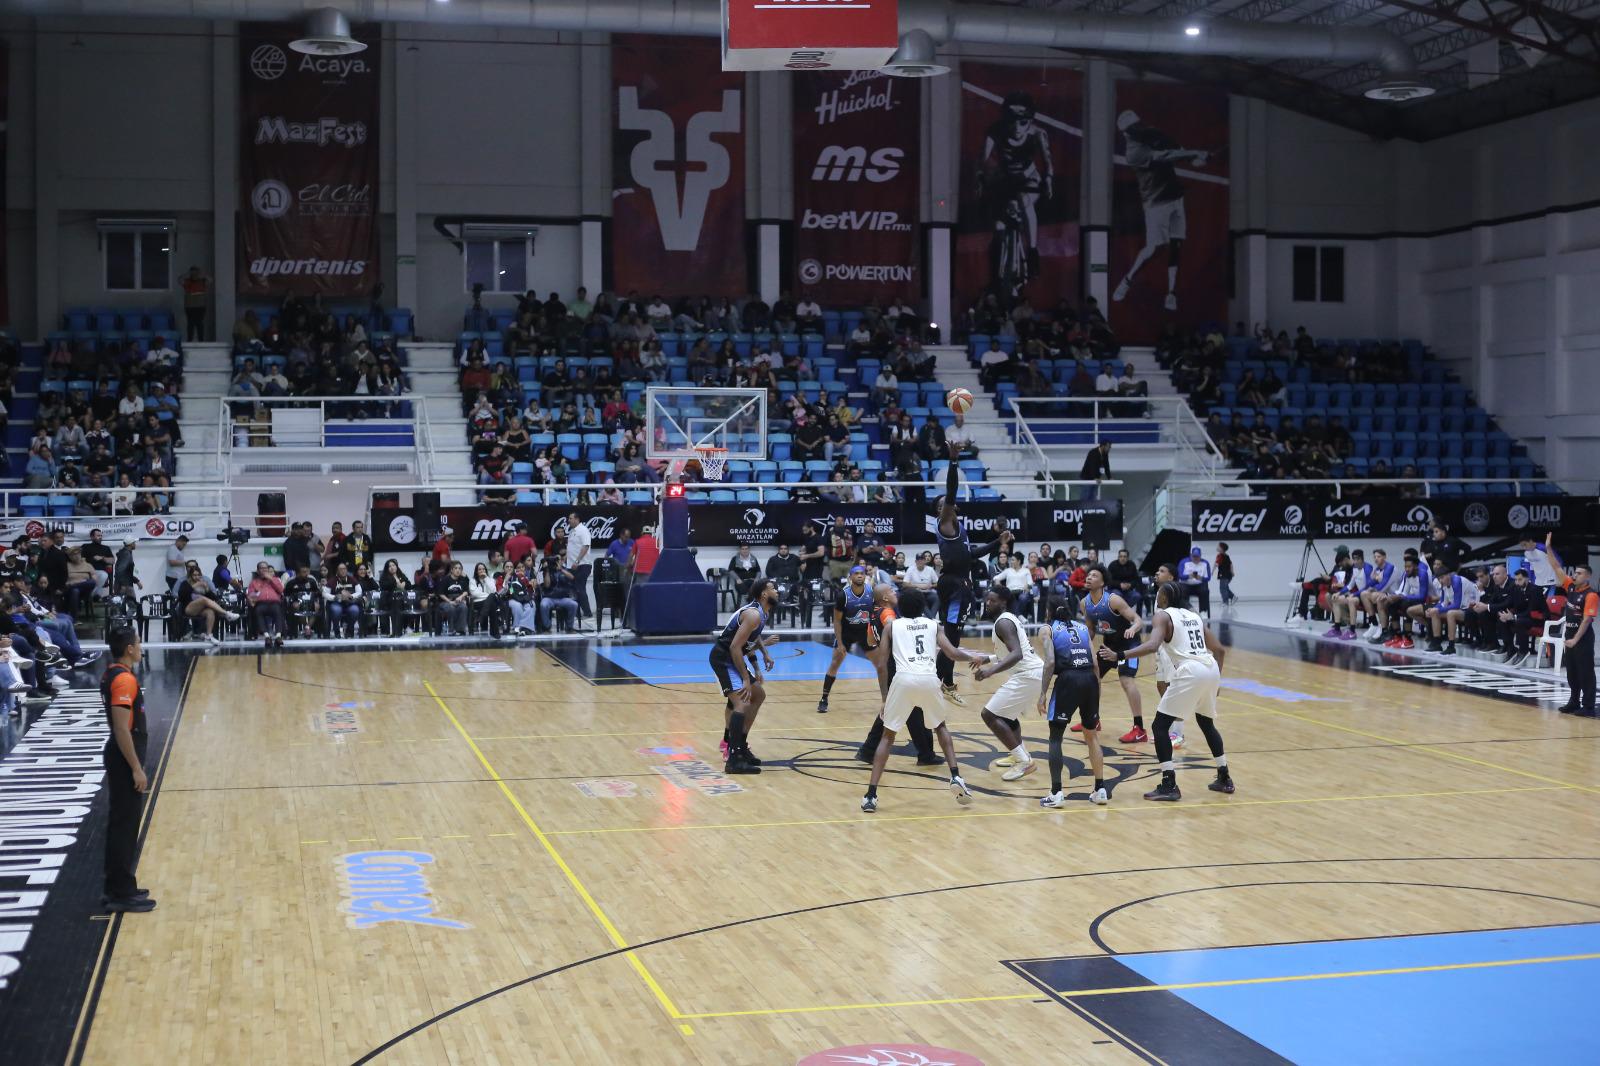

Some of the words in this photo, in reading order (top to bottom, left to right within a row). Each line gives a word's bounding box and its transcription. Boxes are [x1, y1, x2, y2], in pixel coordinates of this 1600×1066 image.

[815, 79, 893, 125] Huichol
[256, 117, 366, 147] MazFest
[811, 145, 905, 182] ms
[670, 486, 682, 495] 24
[1053, 509, 1106, 523] POW
[1196, 508, 1267, 533] telcel
[1529, 505, 1561, 522] UAD
[166, 520, 195, 532] CID
[856, 525, 894, 534] FINESS
[1279, 525, 1307, 534] MEGA
[1325, 521, 1370, 534] Pacific
[1391, 523, 1418, 532] Banco
[915, 634, 925, 655] 5
[1067, 628, 1082, 645] 3
[1187, 629, 1205, 650] 55
